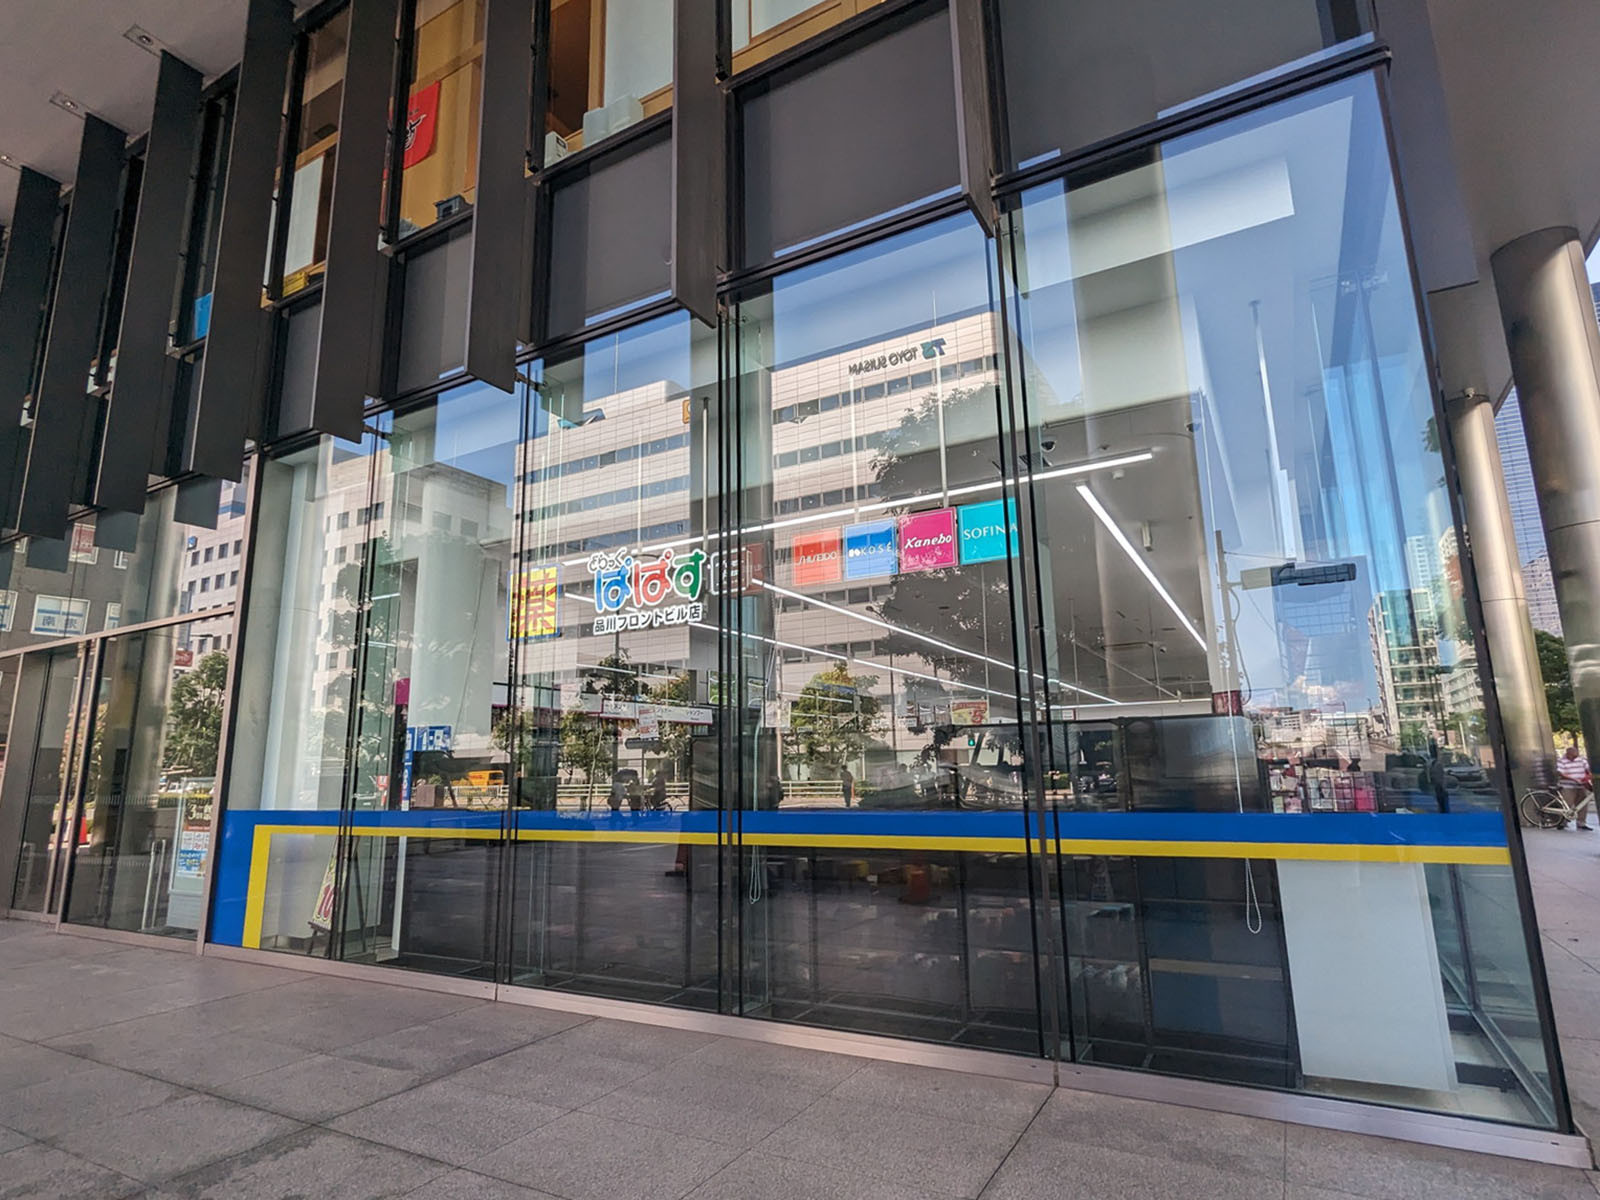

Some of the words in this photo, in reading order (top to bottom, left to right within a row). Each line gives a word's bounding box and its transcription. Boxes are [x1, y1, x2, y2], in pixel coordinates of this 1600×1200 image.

[904, 532, 953, 550] Kanebo
[963, 522, 1018, 540] SOFINA
[594, 549, 706, 611] ぱぱす
[594, 604, 701, 633] 品川フロントビル店
